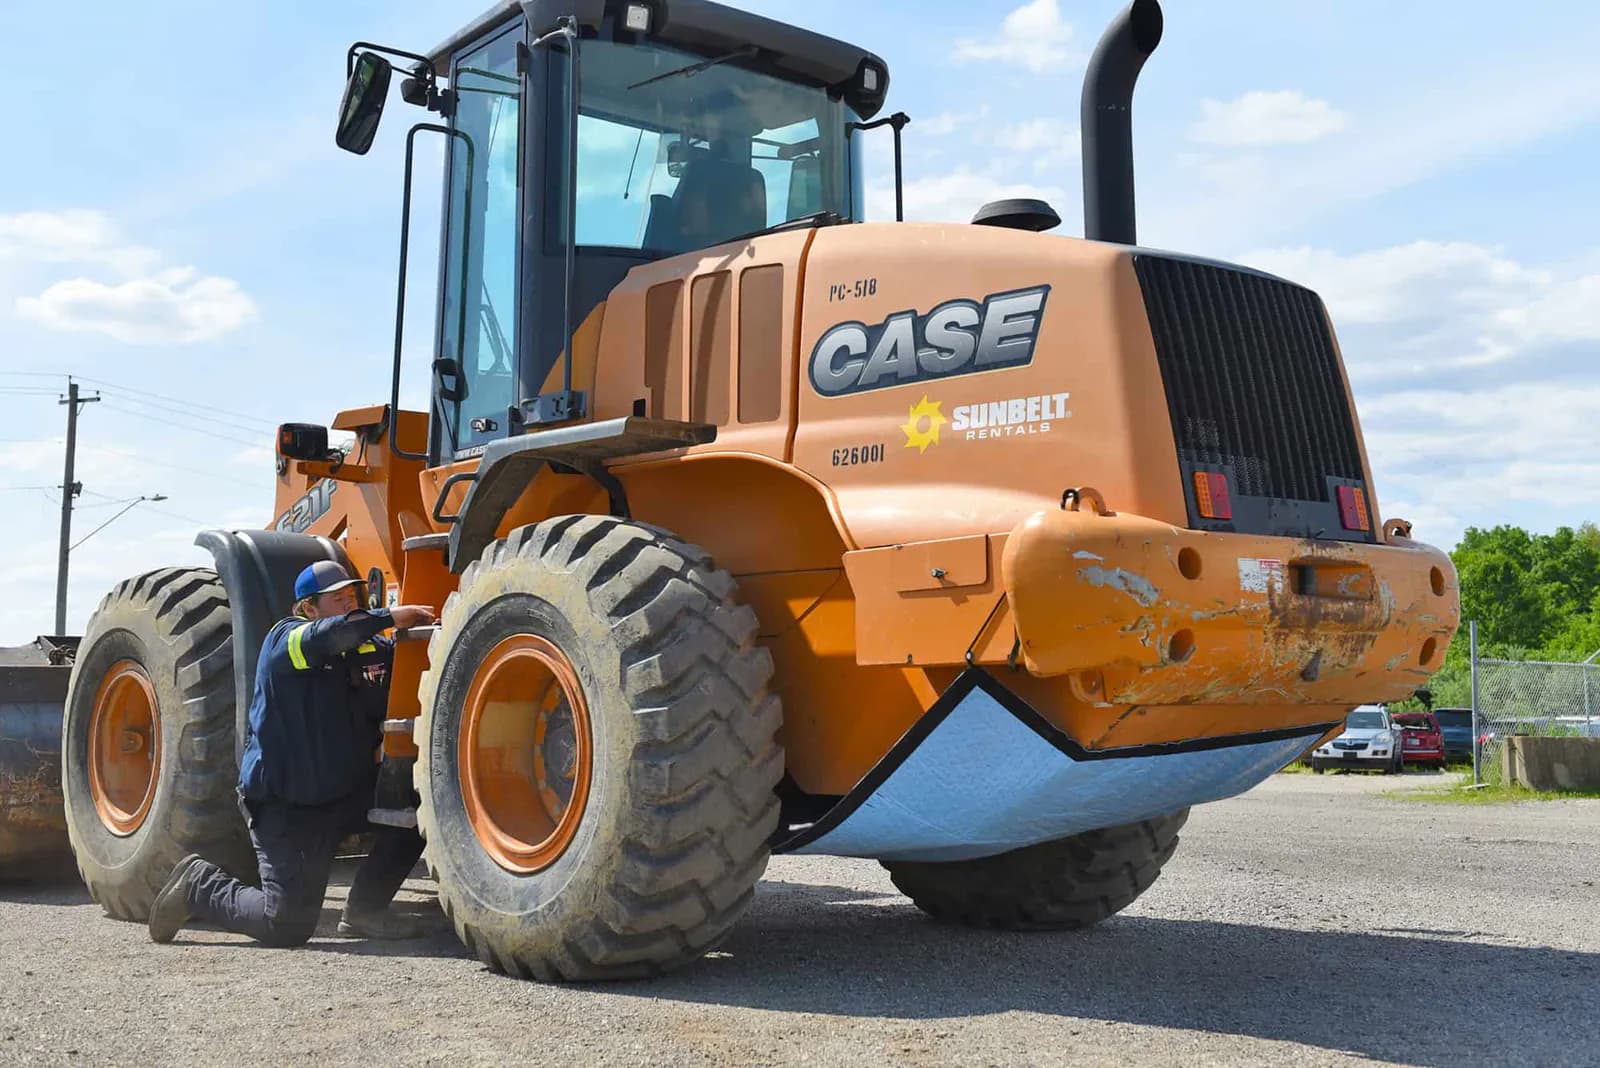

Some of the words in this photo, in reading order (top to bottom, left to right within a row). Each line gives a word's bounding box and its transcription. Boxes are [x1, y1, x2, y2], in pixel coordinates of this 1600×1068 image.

[829, 278, 877, 303] PC-518
[810, 288, 1049, 395] CASE
[951, 392, 1069, 431] SUNBELT
[965, 422, 1051, 441] RENTALS
[832, 443, 885, 467] 626001
